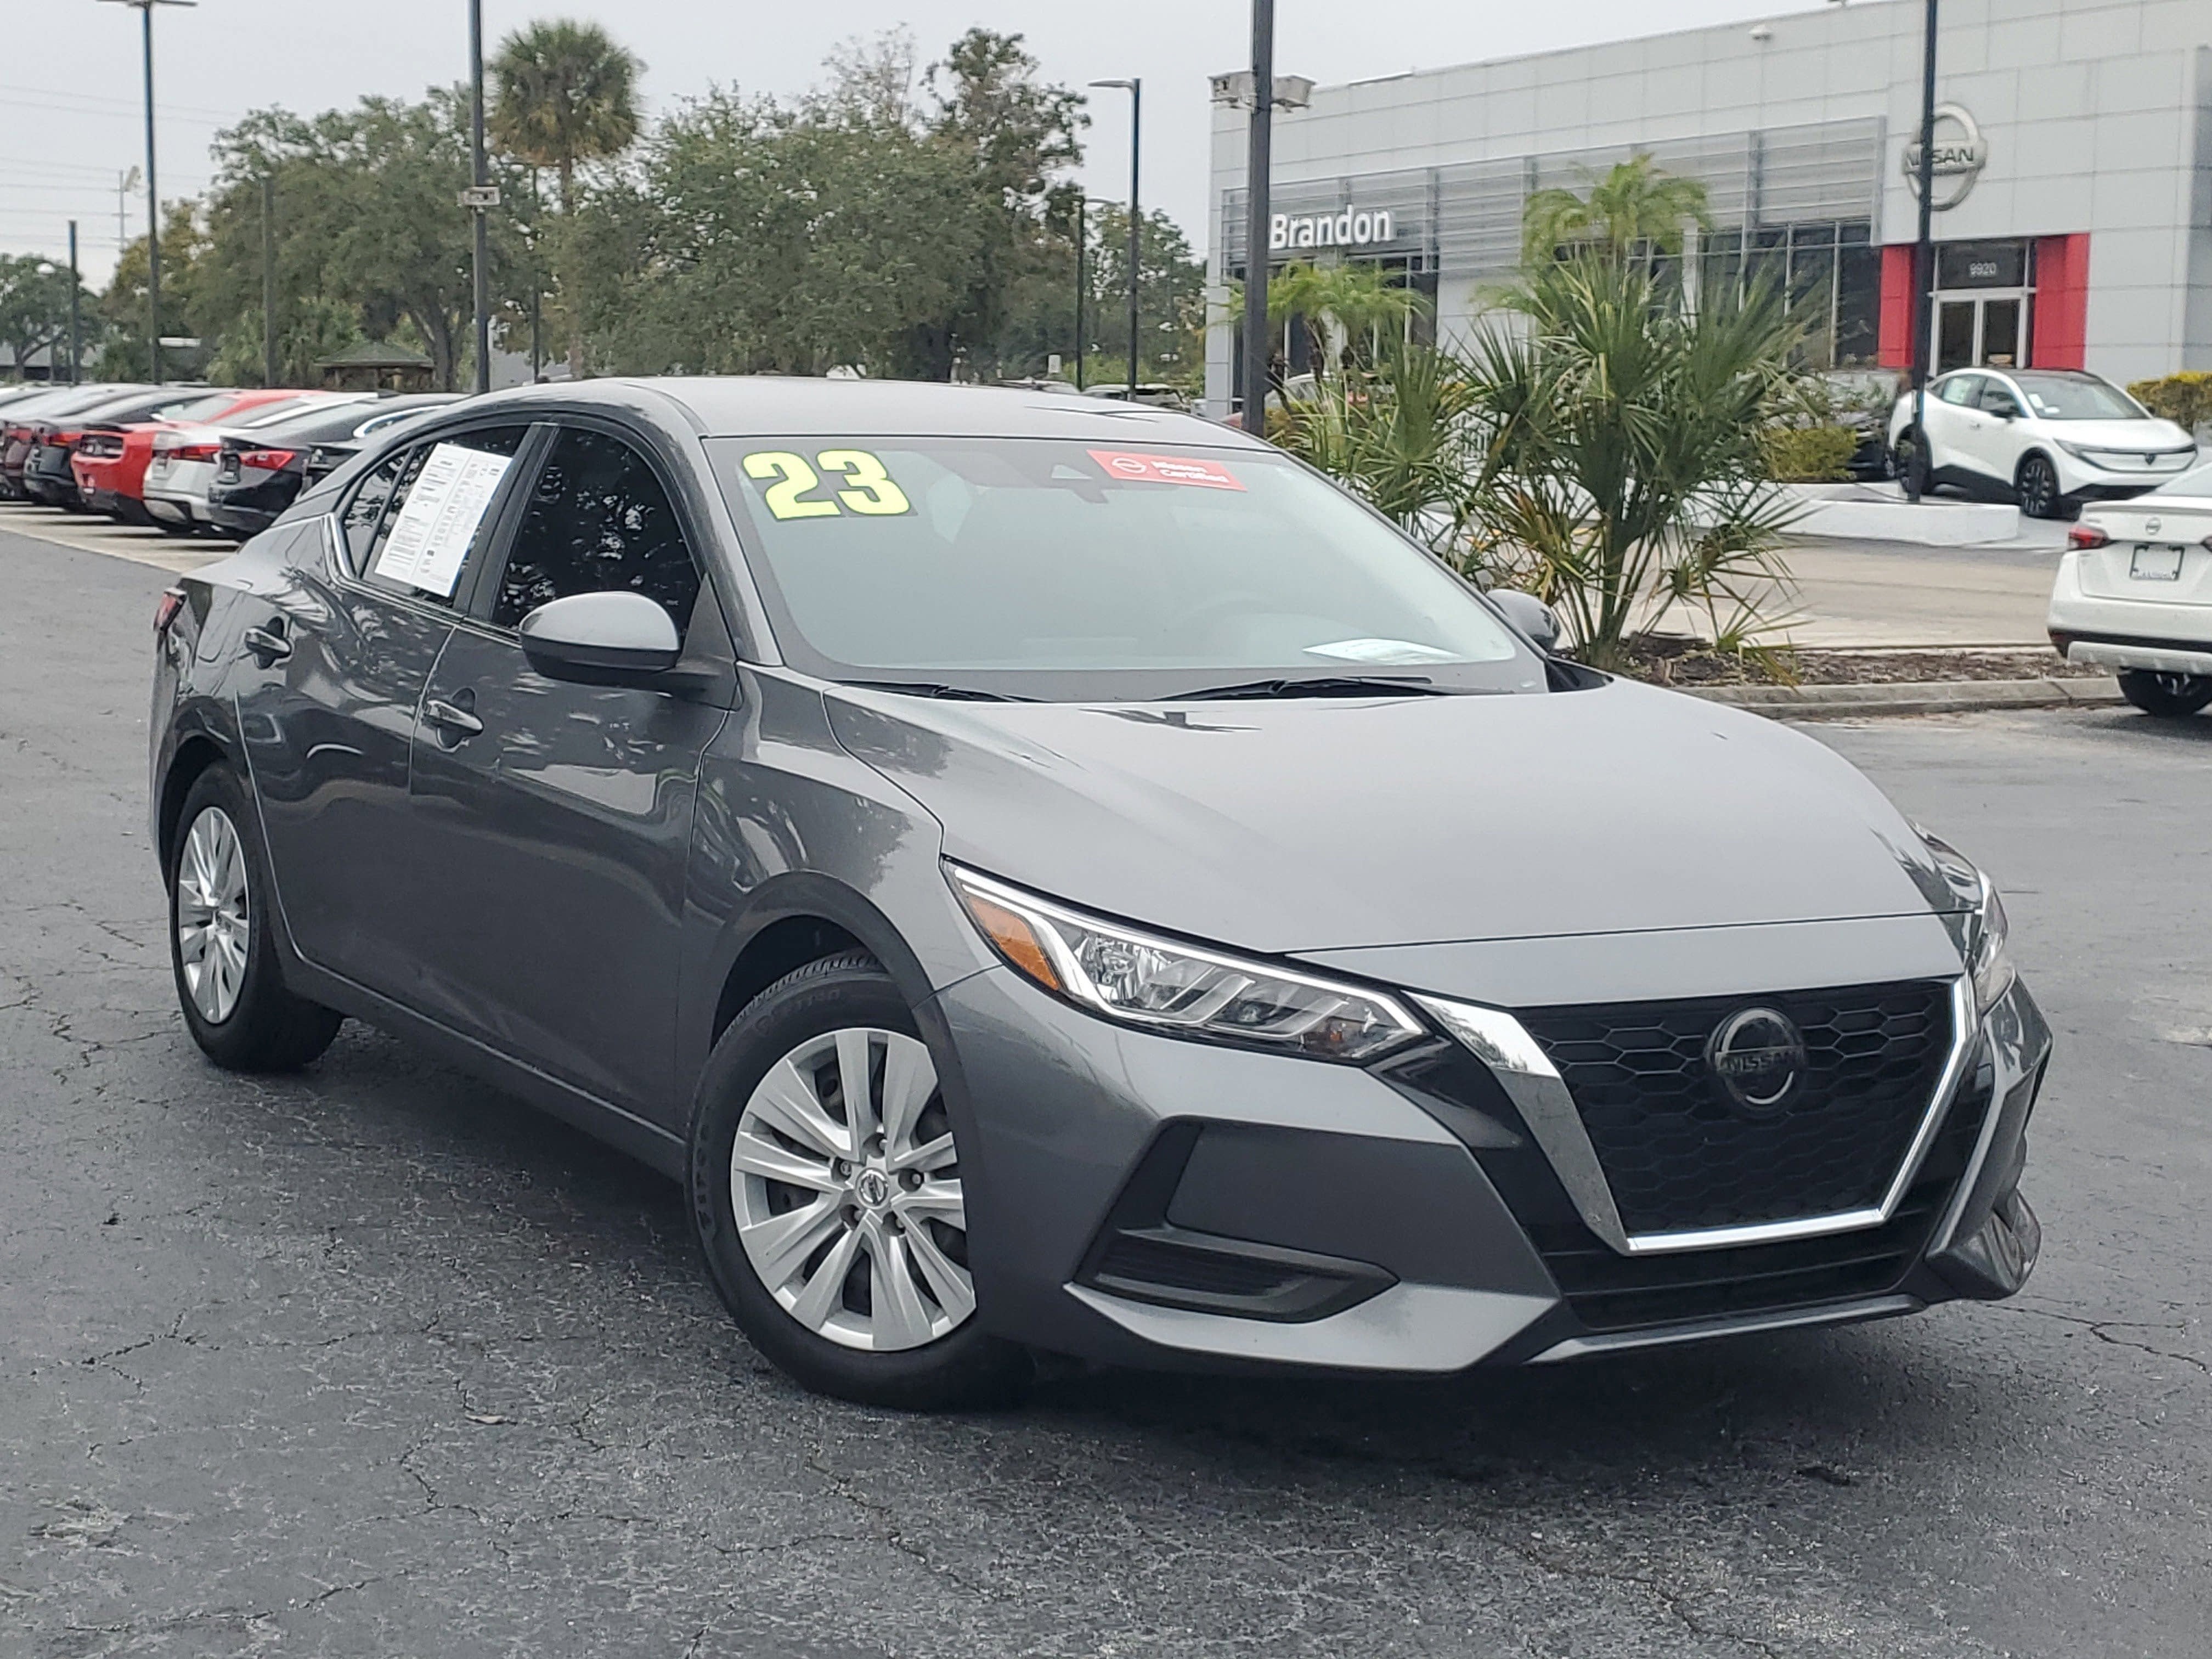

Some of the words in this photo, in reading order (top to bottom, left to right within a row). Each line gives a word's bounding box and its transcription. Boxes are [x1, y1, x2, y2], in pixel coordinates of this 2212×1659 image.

[1906, 146, 1974, 166] NSAN
[1269, 204, 1392, 249] Brandon
[743, 449, 910, 522] 23
